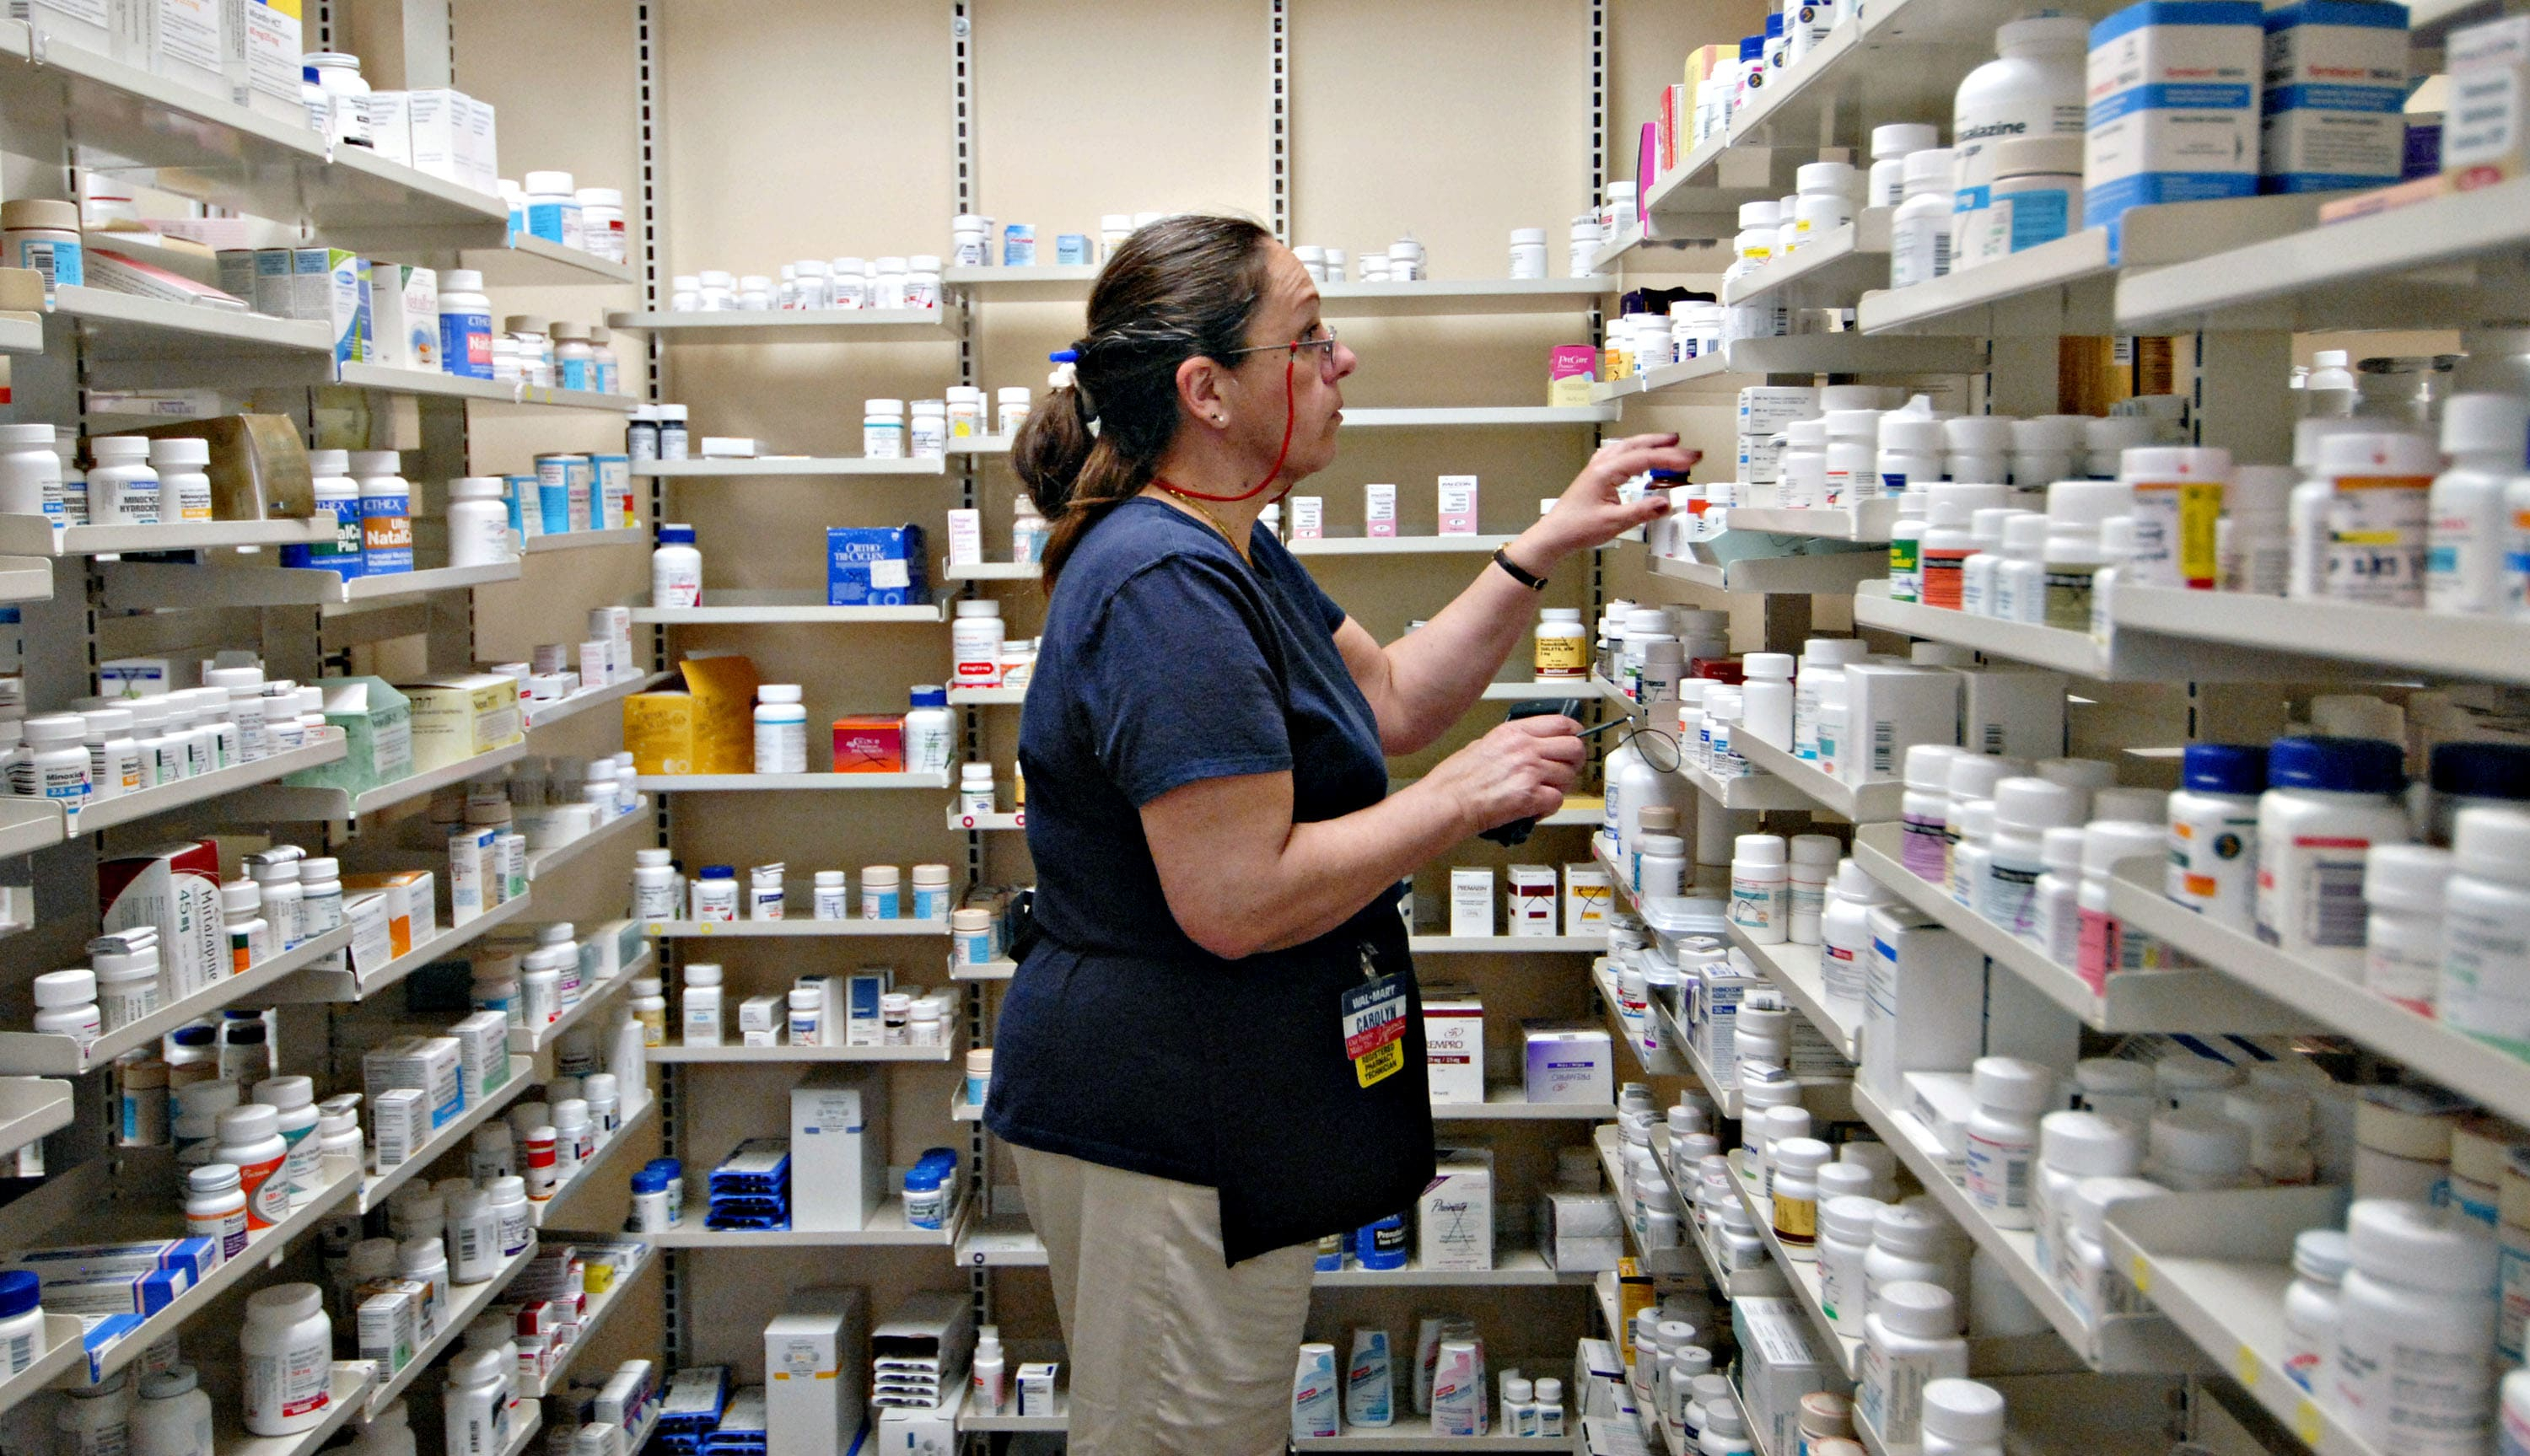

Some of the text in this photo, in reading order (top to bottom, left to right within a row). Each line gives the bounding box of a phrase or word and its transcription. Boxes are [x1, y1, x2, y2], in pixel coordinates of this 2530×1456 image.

[315, 501, 348, 514] THEX
[363, 498, 401, 512] ETHEX
[179, 889, 192, 916] 45
[201, 888, 218, 981] Mirtazapine
[1356, 1002, 1397, 1034] CAROLYN
